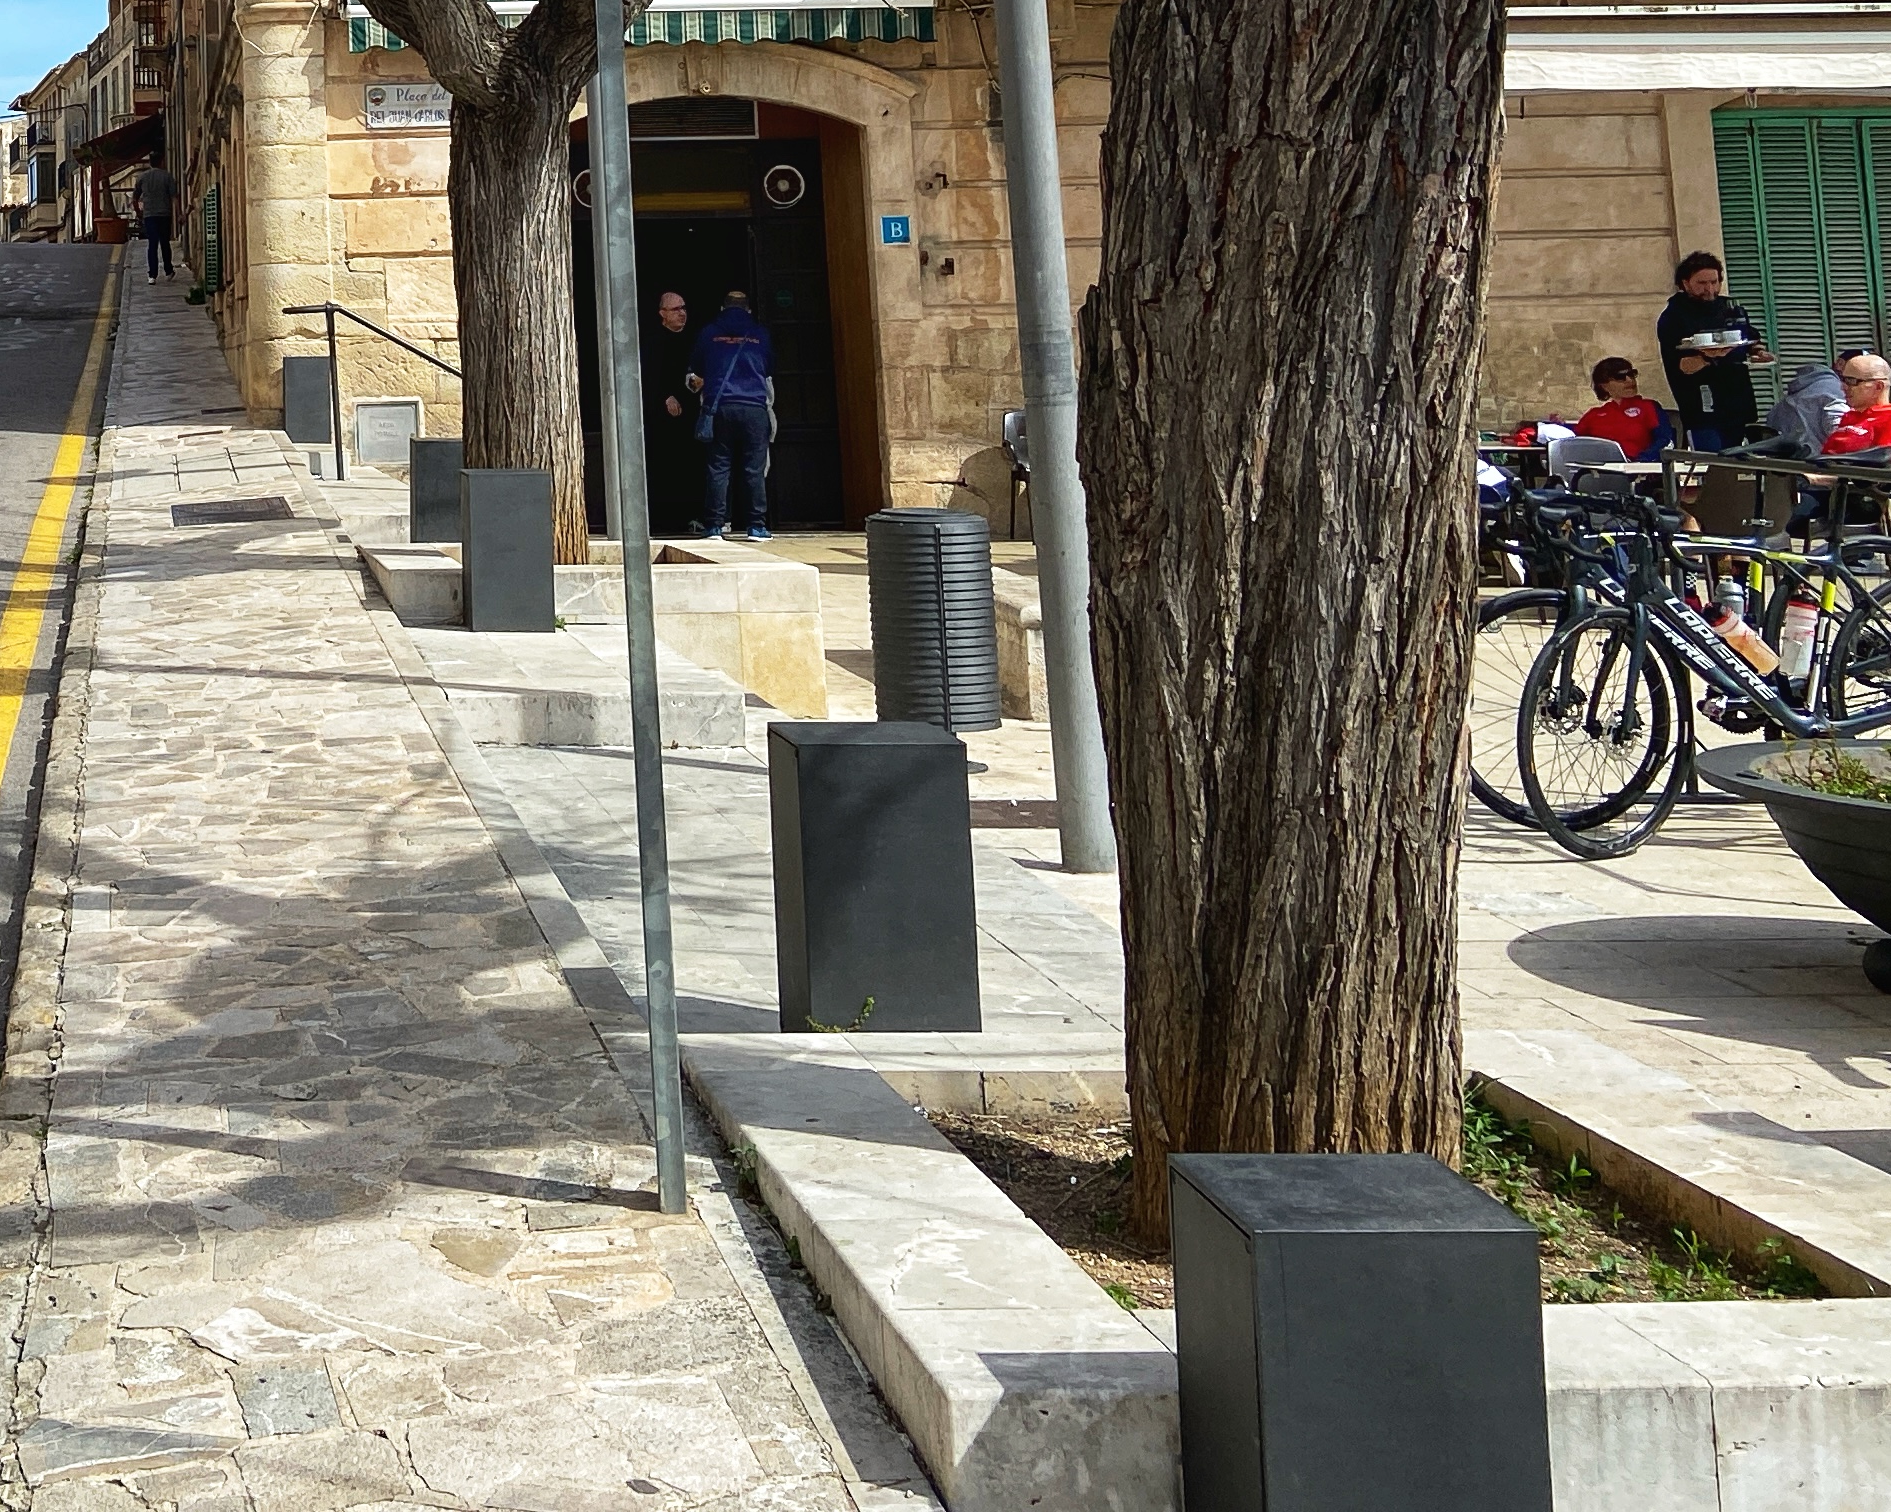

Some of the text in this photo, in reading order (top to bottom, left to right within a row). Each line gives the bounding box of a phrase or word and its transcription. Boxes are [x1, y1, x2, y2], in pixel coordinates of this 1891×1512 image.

[396, 87, 447, 102] Plaça del
[414, 108, 446, 123] CARLOS
[890, 221, 903, 238] B
[1663, 596, 1778, 701] LAPIERRE
